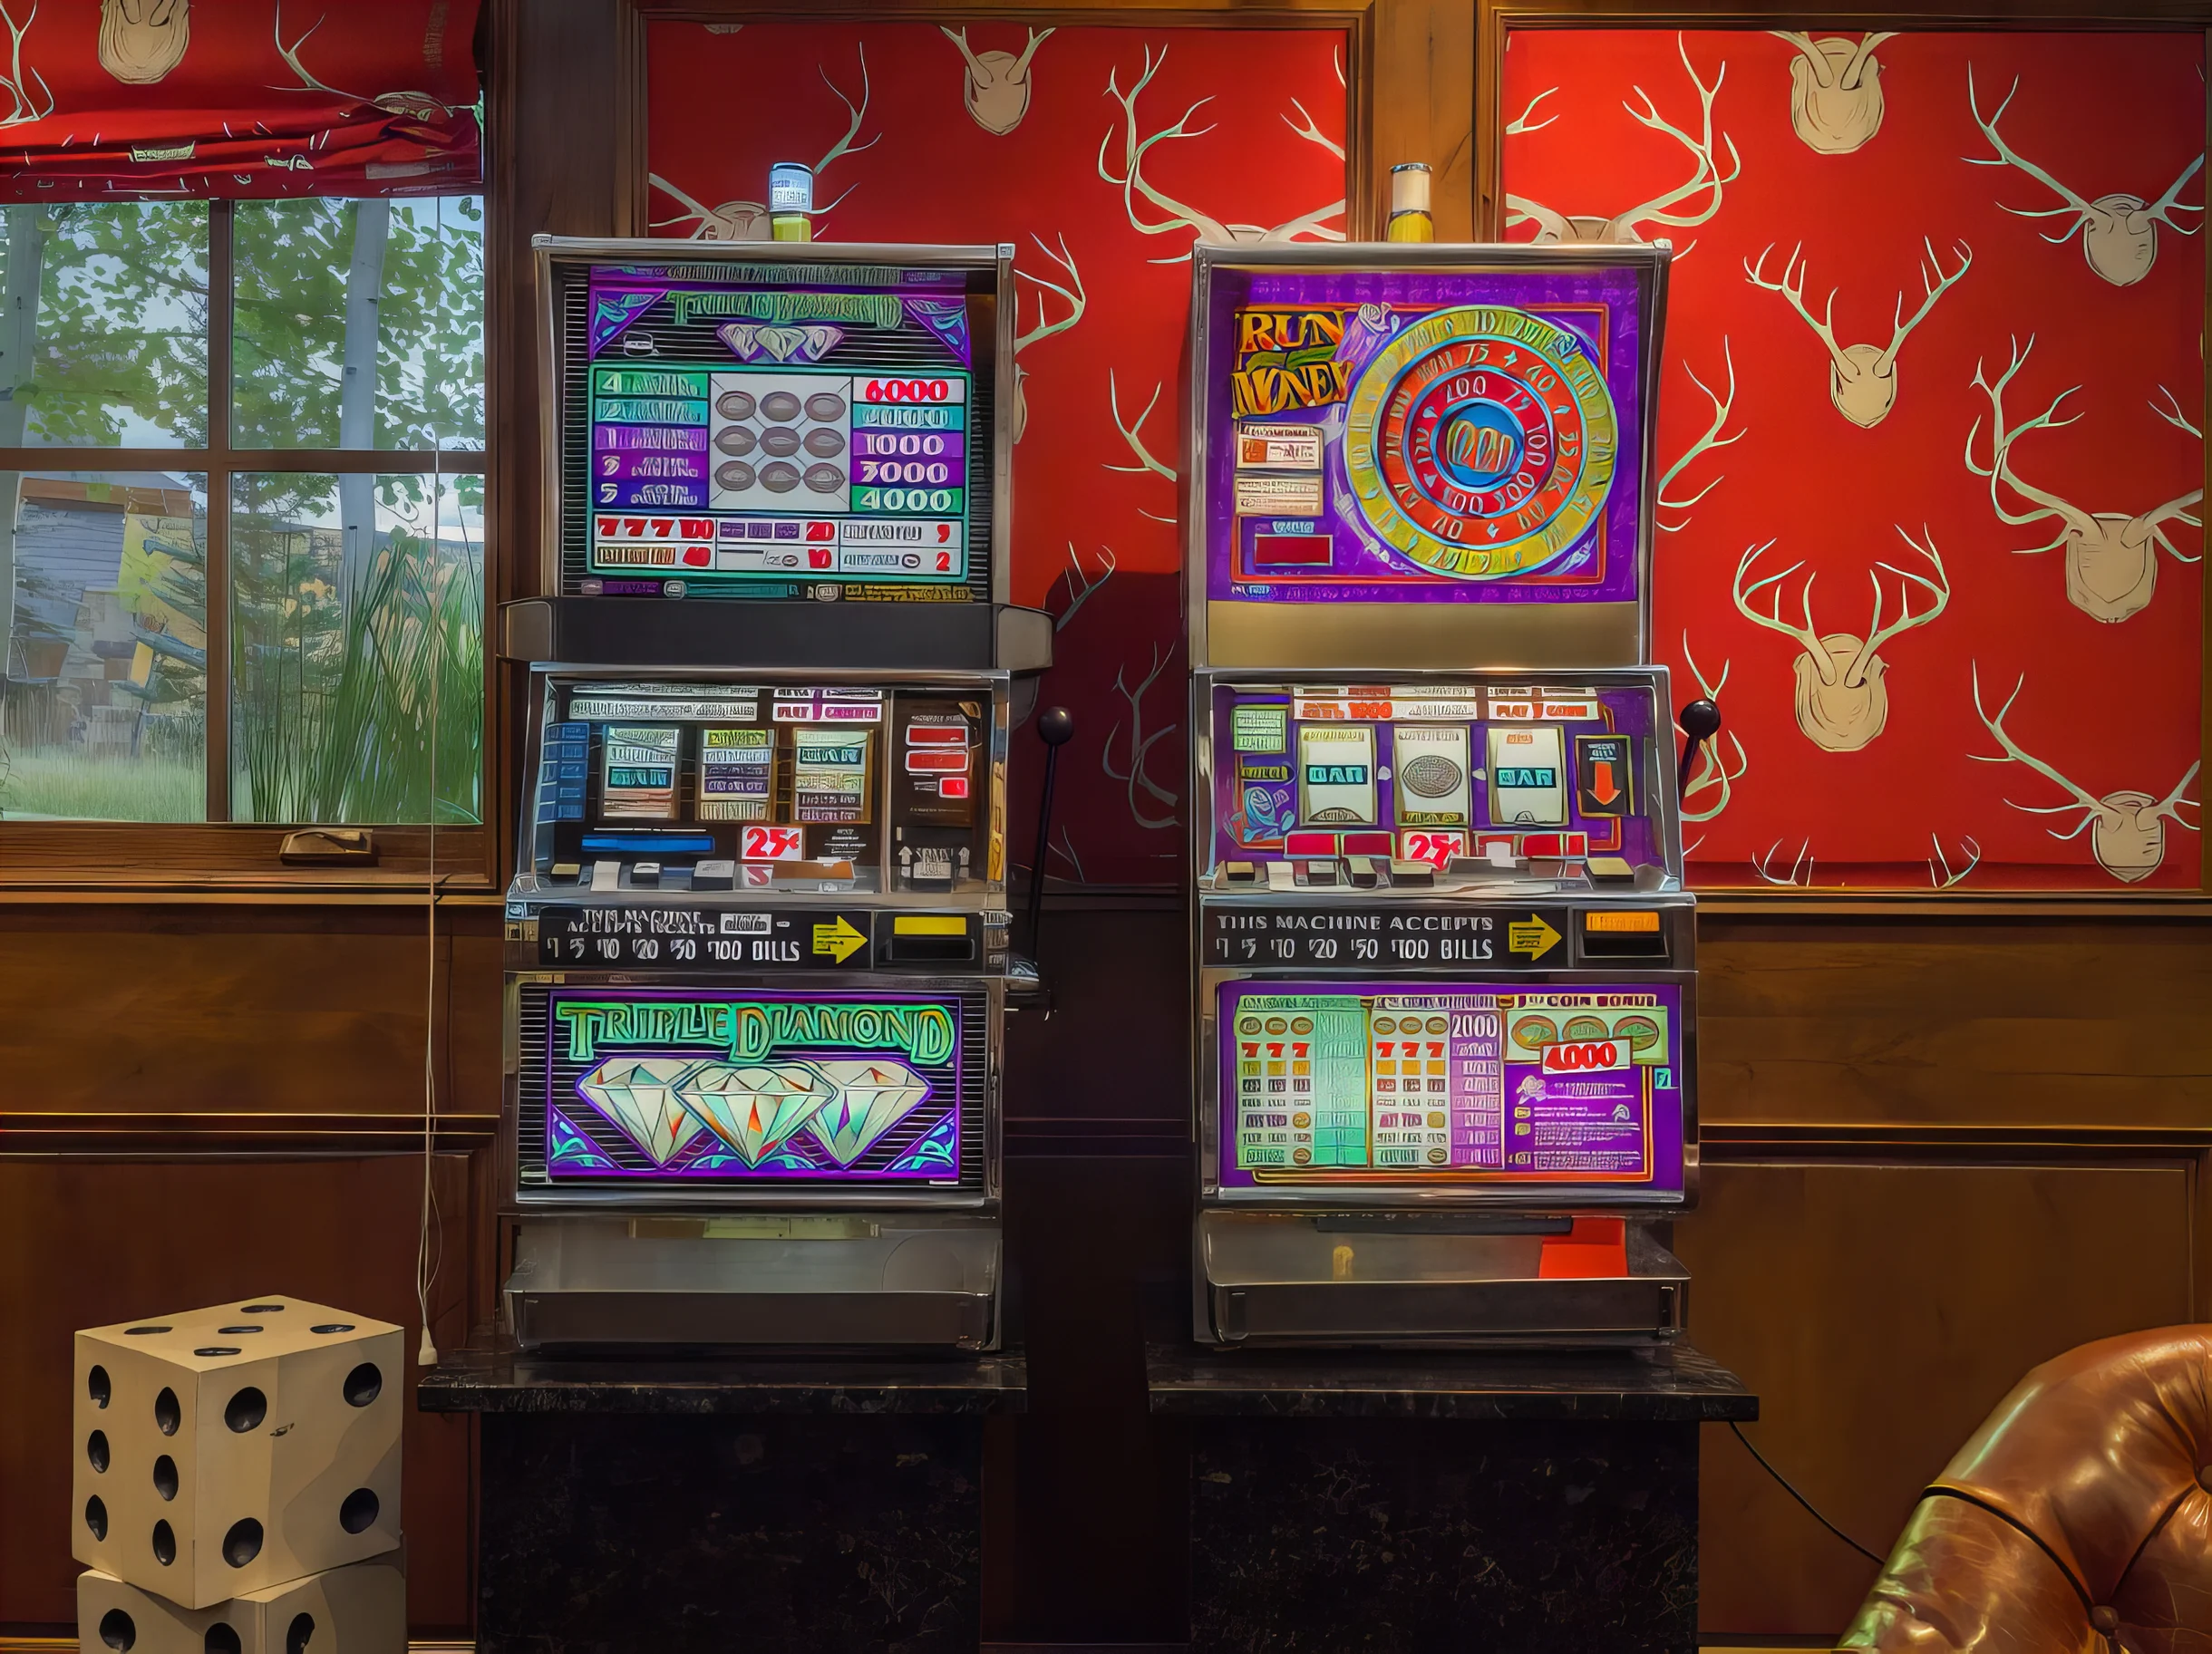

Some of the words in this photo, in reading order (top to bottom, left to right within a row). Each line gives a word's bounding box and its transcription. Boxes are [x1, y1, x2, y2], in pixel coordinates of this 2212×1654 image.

[1240, 311, 1344, 353] RUN
[865, 379, 949, 402] 6000
[864, 433, 945, 456] 1000
[859, 488, 952, 512] 4000
[1217, 915, 1267, 929] THIS
[1276, 915, 1381, 930] MACHINE
[1441, 938, 1494, 960] BILLS
[557, 1001, 729, 1060] TRIPLE
[729, 1002, 956, 1064] DIAMOND
[1451, 1013, 1498, 1039] 2000
